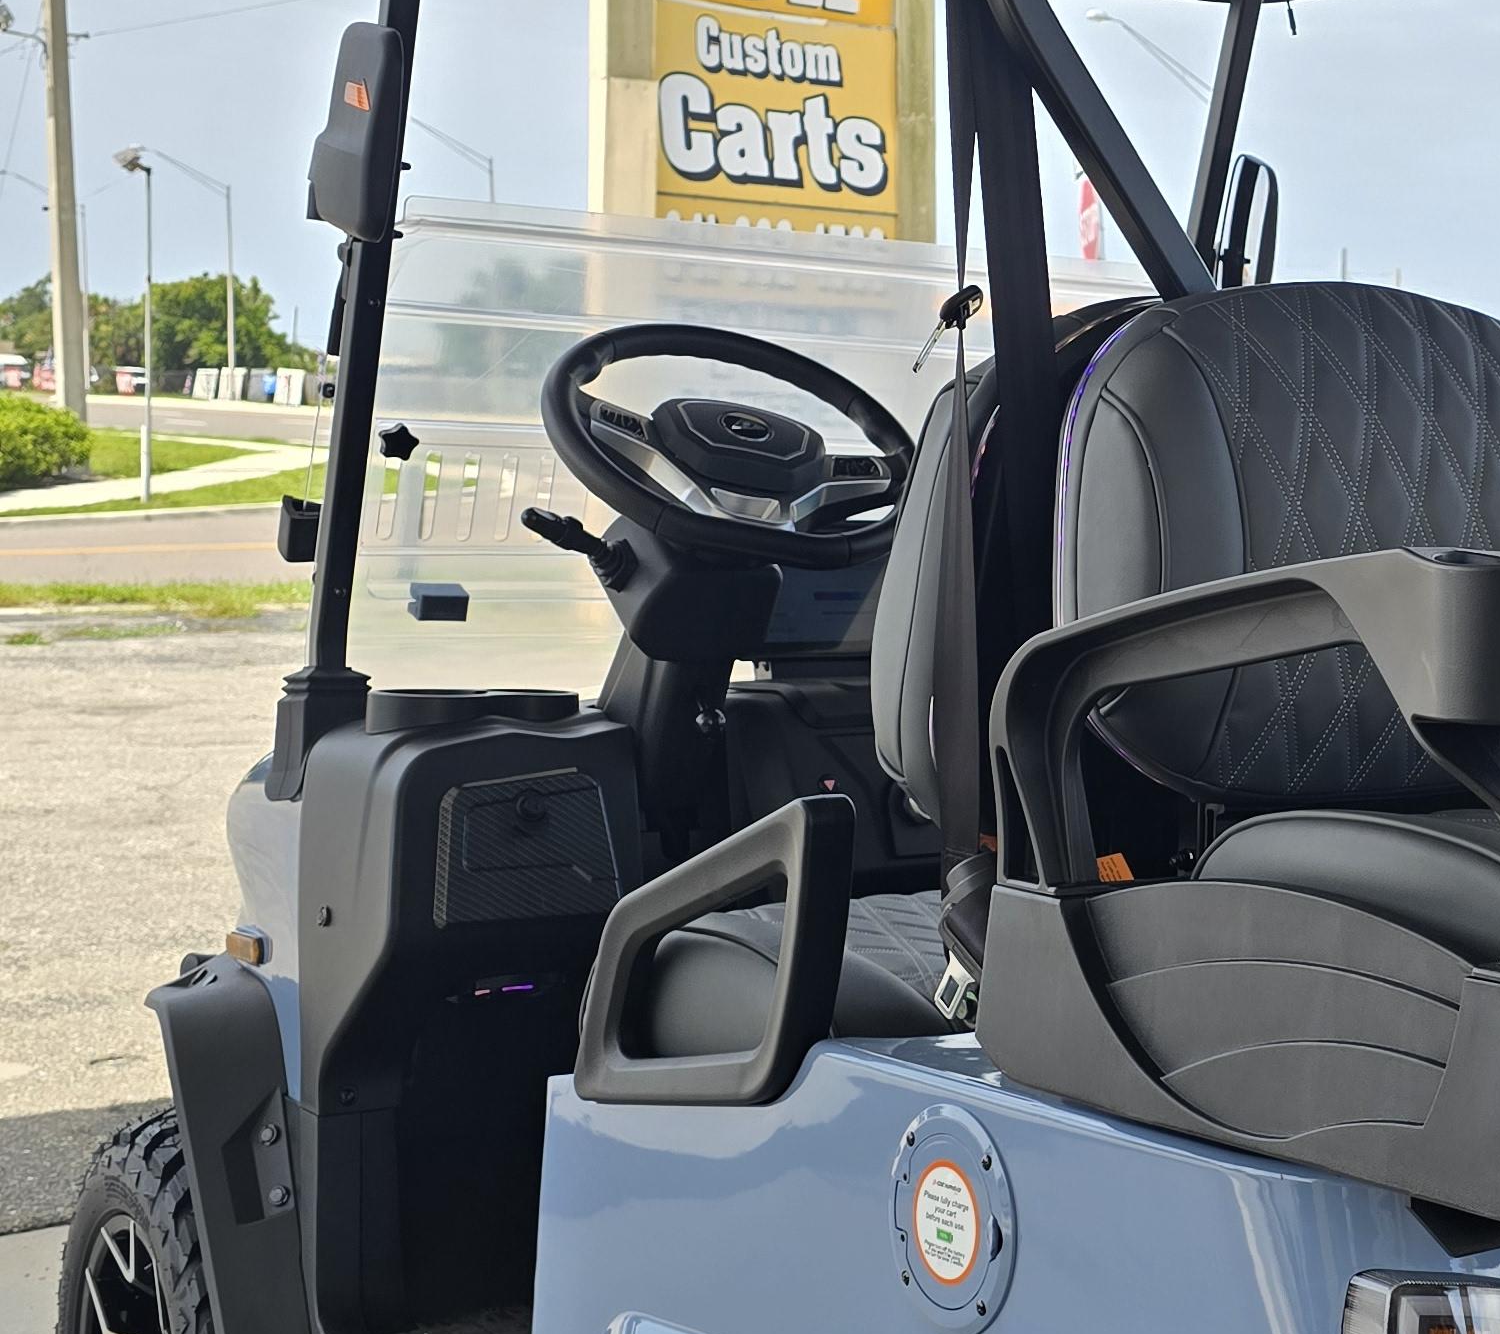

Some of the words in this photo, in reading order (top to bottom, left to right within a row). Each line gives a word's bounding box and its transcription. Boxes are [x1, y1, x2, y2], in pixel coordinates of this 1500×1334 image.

[696, 13, 844, 86] Custom
[657, 71, 888, 196] Carts
[924, 1190, 939, 1201] Please
[952, 1201, 969, 1212] charge
